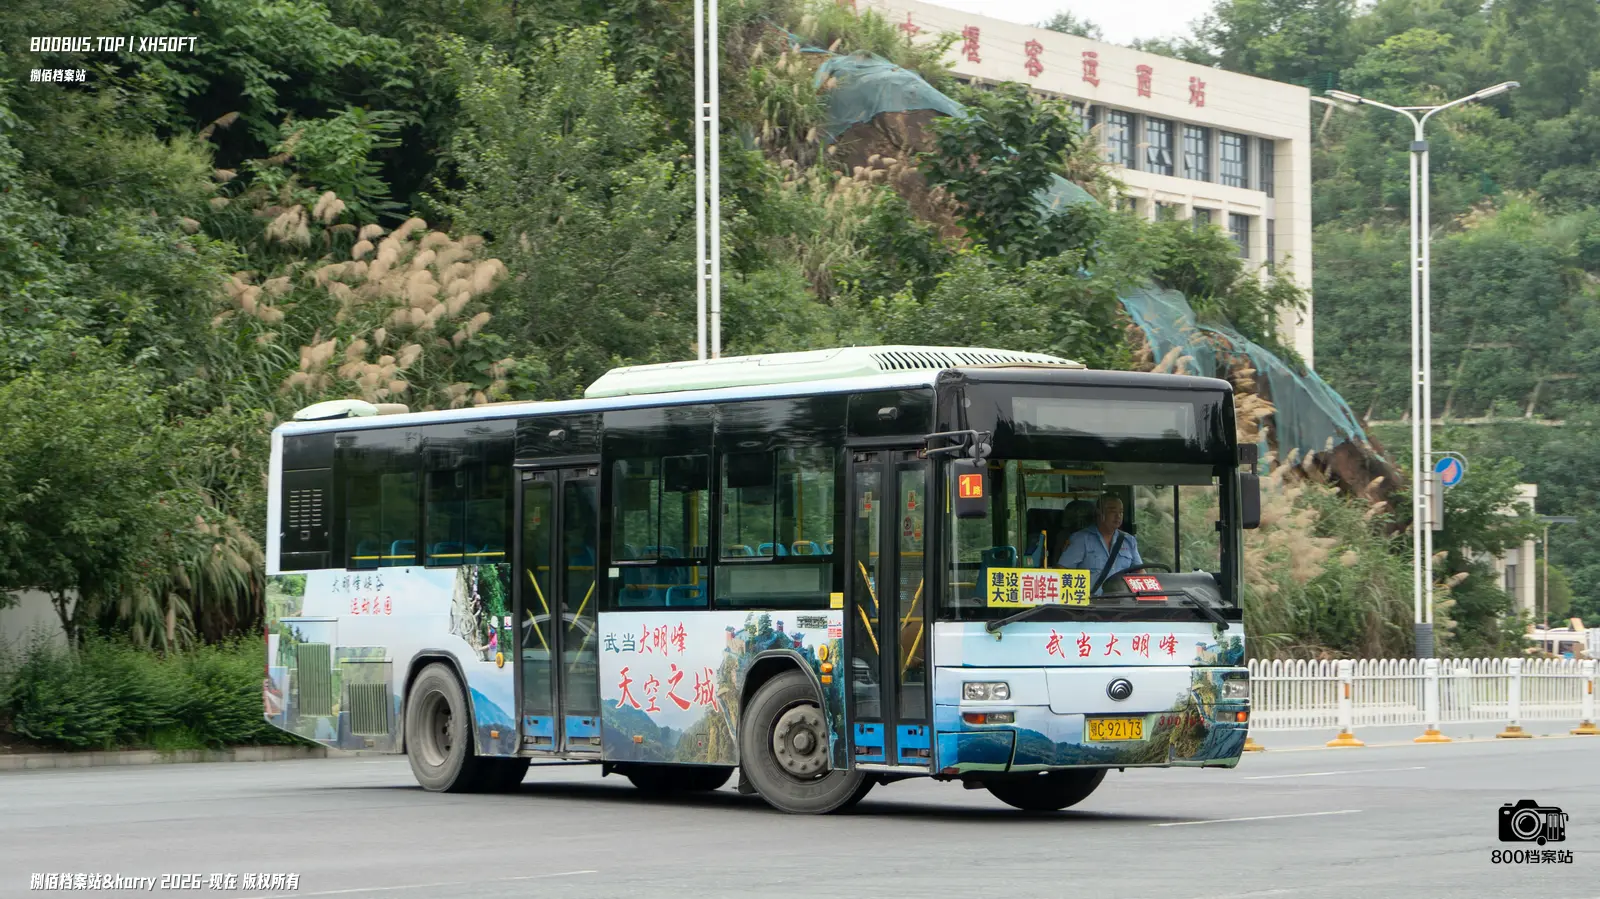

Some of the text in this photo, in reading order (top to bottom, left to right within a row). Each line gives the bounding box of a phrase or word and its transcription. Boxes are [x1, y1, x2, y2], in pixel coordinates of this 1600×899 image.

[961, 476, 981, 496] 1路
[991, 572, 1019, 588] 建设
[1021, 574, 1059, 602] 高峰车
[1061, 573, 1087, 588] 黄龙
[991, 587, 1019, 603] 大道
[1061, 589, 1087, 604] 小学
[604, 621, 687, 657] 武当大明峰
[1045, 629, 1179, 659] 武当大明峰
[615, 663, 719, 712] 天空之城
